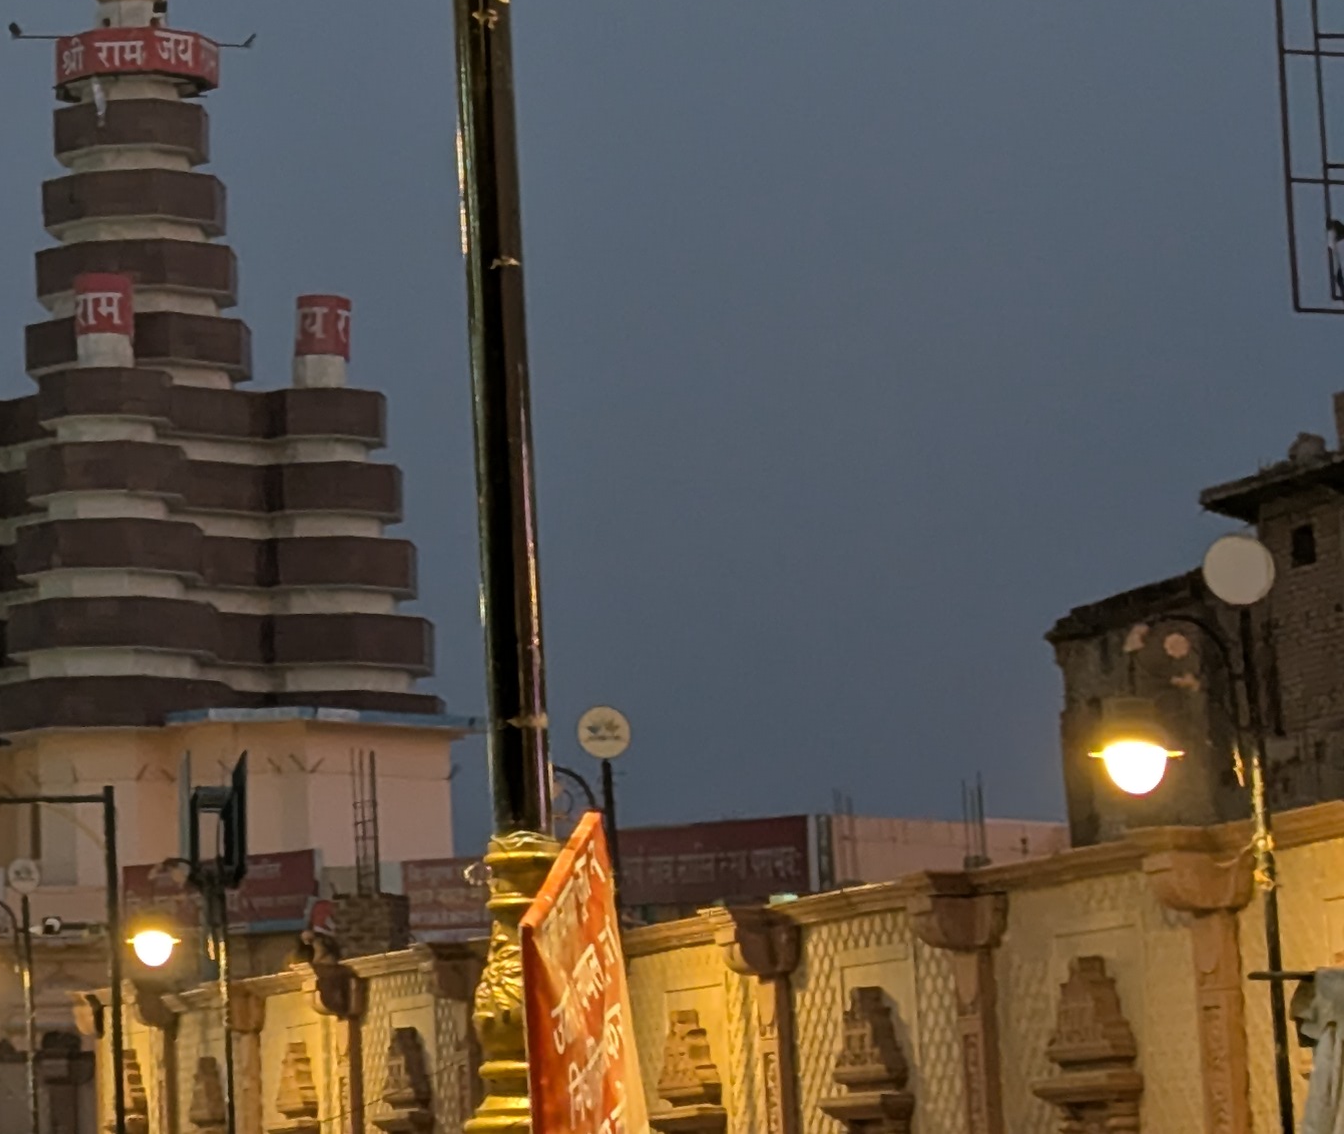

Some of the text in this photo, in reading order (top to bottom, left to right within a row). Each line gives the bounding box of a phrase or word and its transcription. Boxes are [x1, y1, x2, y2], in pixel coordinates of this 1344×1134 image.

[62, 38, 85, 75] श्री
[95, 40, 145, 69] राम
[154, 30, 193, 67] जय
[75, 292, 123, 326] राम
